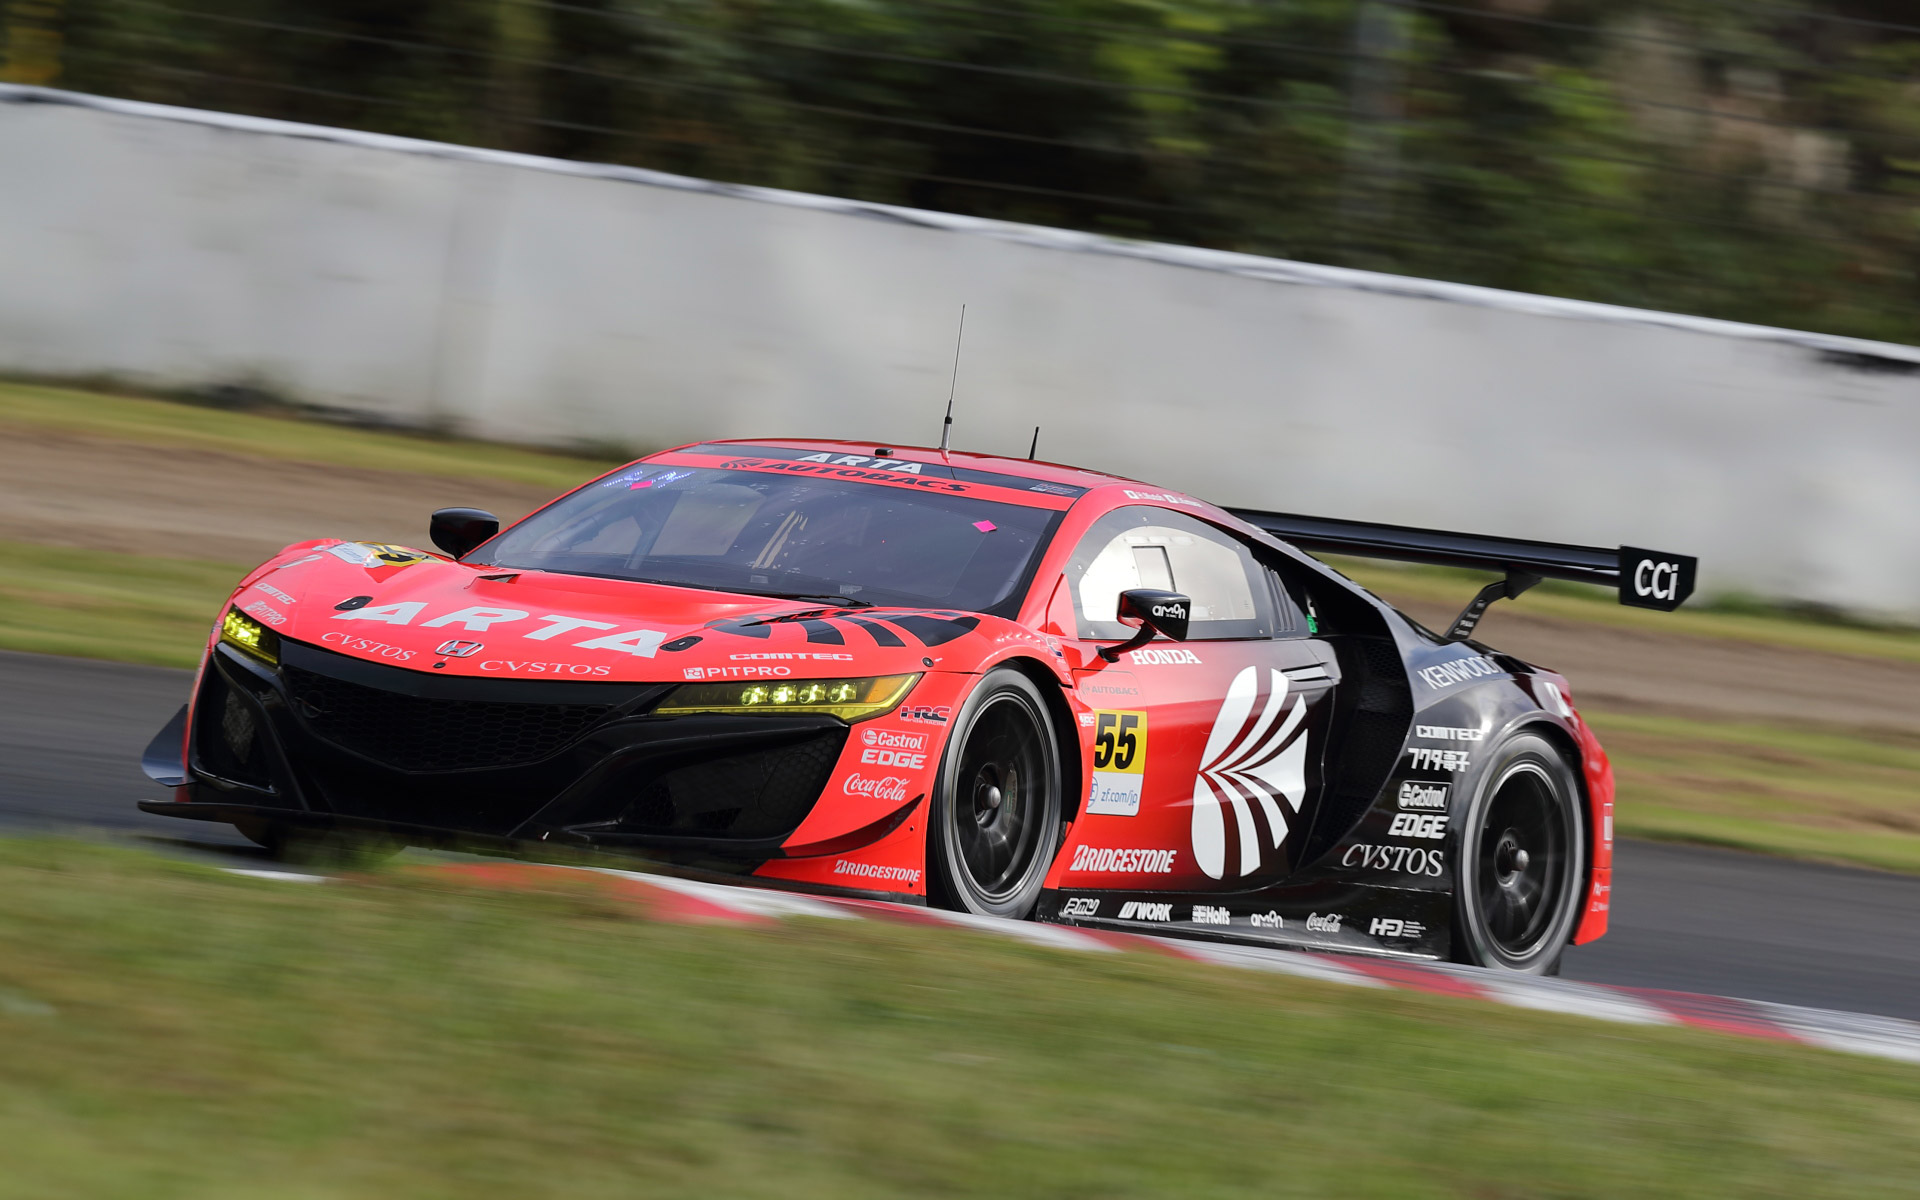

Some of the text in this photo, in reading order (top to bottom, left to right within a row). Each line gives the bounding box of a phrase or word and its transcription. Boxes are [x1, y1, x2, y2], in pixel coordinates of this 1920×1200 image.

[796, 452, 923, 475] ARTA
[761, 461, 972, 492] AUTOBACS
[1634, 559, 1679, 601] CCi
[254, 583, 296, 605] COMTEC
[1152, 603, 1187, 620] amon
[329, 601, 669, 659] ARTA
[321, 632, 416, 661] CVSTOS
[729, 652, 853, 661] COMTEC
[1128, 649, 1202, 665] HONDA
[480, 659, 611, 676] CVSTOS
[706, 666, 791, 678] PITPRO
[1416, 656, 1503, 690] KENWOOD
[1091, 685, 1139, 696] AUTOBACS
[900, 706, 951, 722] HRC
[877, 731, 923, 750] Castrol
[1094, 713, 1139, 770] 55
[1416, 724, 1483, 741] COMTEC
[860, 748, 928, 770] EDGE
[1101, 787, 1138, 807] zf.com/jp
[1410, 784, 1448, 808] Castrol
[1387, 812, 1450, 840] EDGE
[1069, 844, 1178, 873] BRIDGESTONE
[1342, 843, 1444, 877] CVSTOS
[833, 859, 922, 882] BRIDGESTONE
[1136, 901, 1173, 922] WORK
[1206, 906, 1231, 926] Holts
